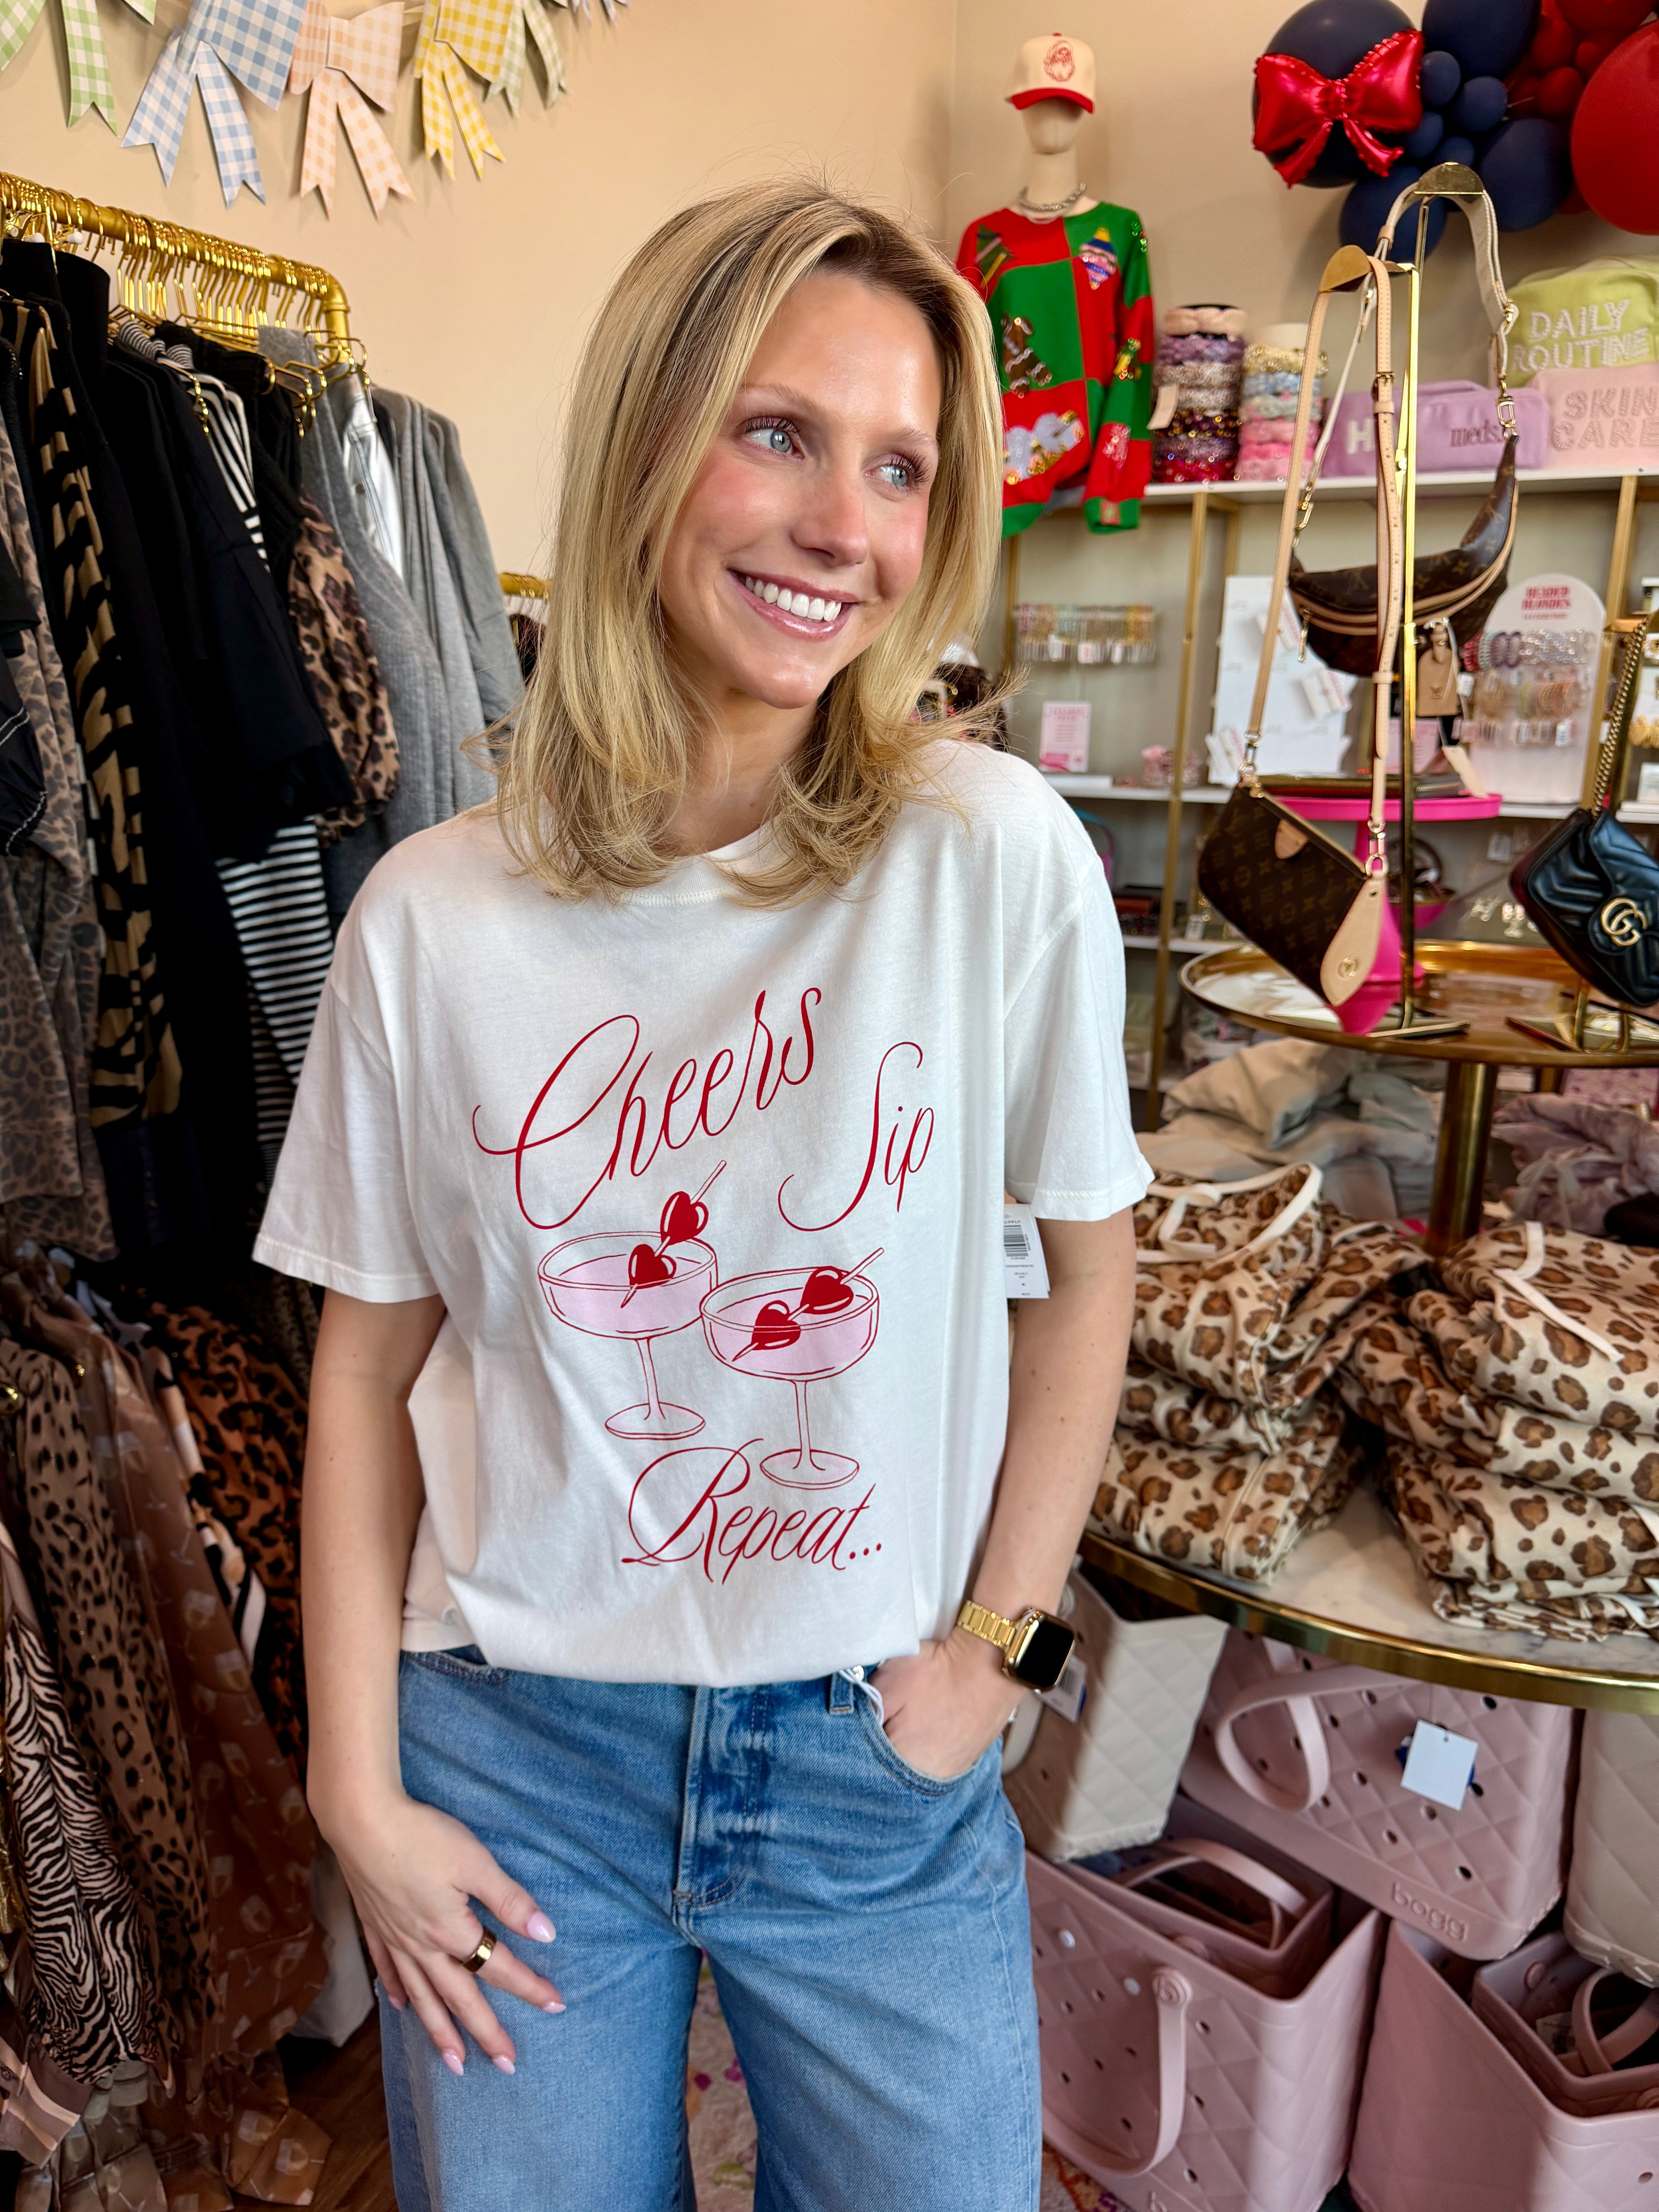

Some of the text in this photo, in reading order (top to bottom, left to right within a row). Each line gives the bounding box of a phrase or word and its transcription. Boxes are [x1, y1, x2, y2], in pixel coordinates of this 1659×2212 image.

[1530, 299, 1630, 342] DAILY
[1512, 328, 1650, 373] ROUTINE
[1563, 386, 1659, 419] SKIN
[1551, 418, 1659, 451] CARE
[472, 987, 822, 1230] Cheers
[778, 1042, 934, 1232] Sip
[621, 1438, 882, 1585] Repeat...
[1393, 1882, 1468, 1941] bogg
